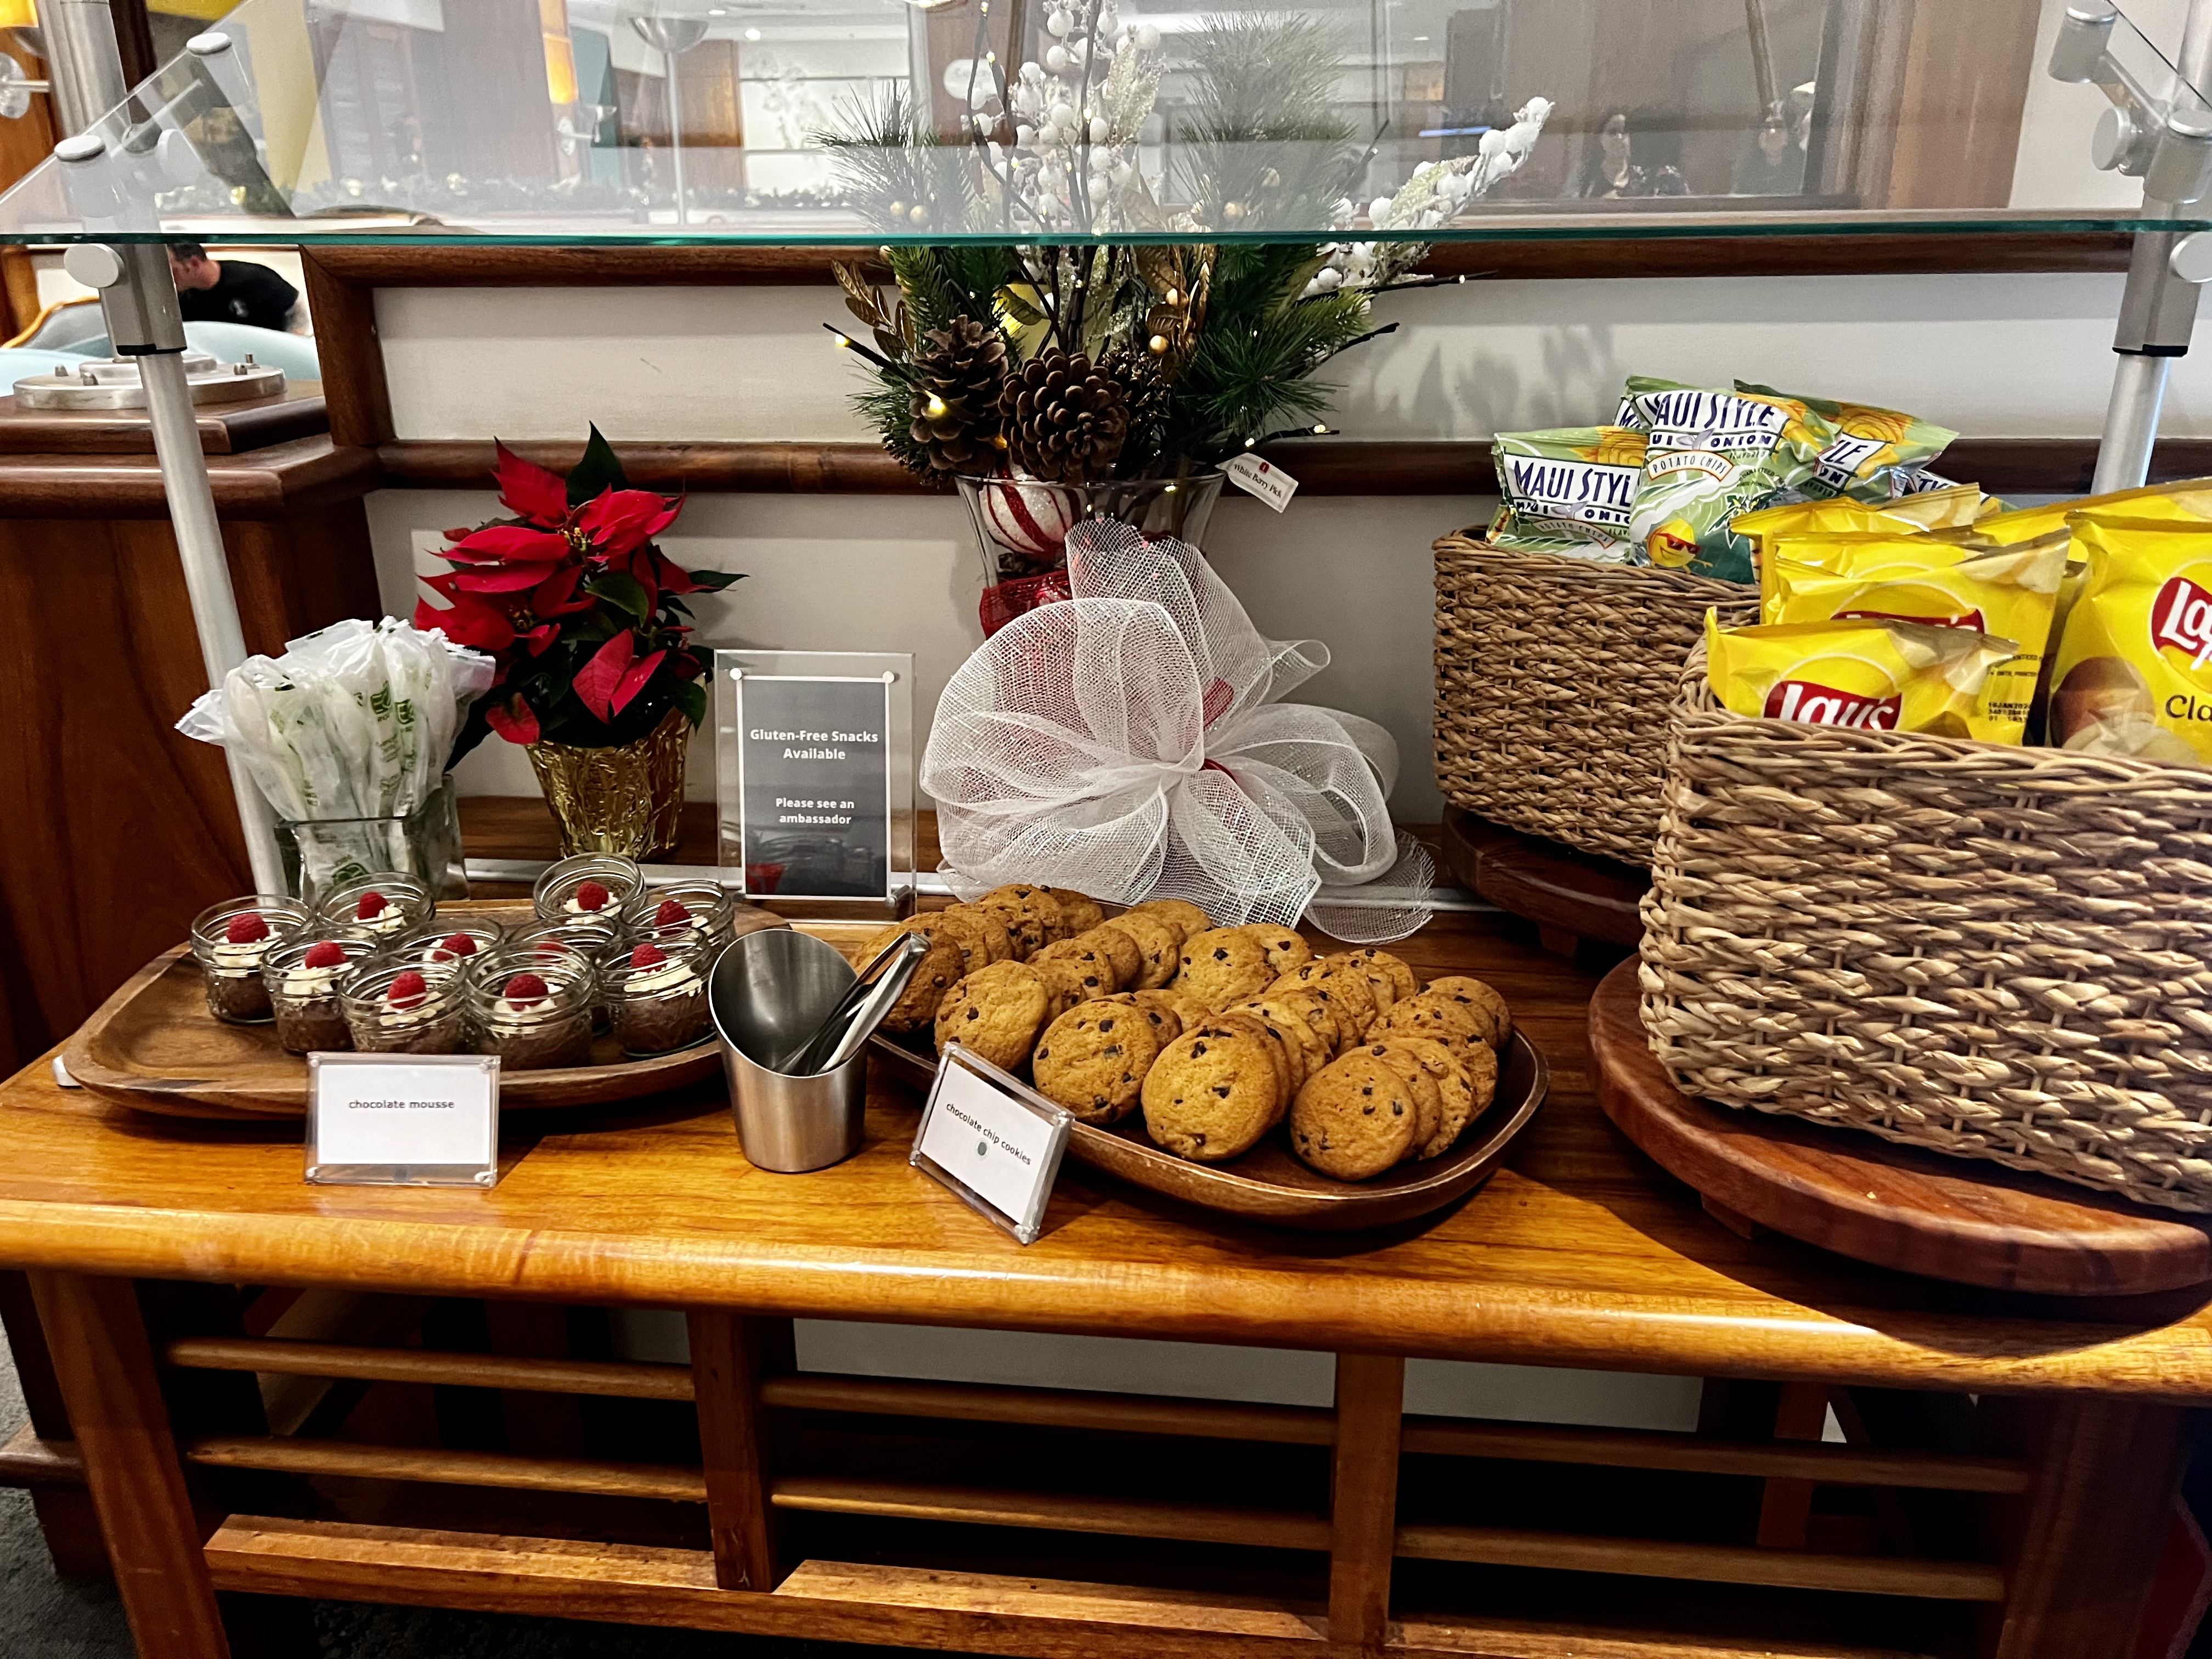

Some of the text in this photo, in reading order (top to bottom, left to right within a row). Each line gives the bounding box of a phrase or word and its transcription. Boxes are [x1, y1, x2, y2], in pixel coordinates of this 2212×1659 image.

[1703, 394, 1774, 430] STYLE
[1710, 434, 1772, 448] ONION
[1653, 455, 1727, 474] POTATO CHIPS
[1234, 464, 1282, 499] White Berry Pick
[1513, 460, 1632, 507] MAUI STYL
[1584, 509, 1630, 524] ONI
[750, 729, 879, 743] Gluten-Free Snacks
[783, 747, 846, 760] Available
[775, 797, 855, 809] Please see an
[779, 814, 852, 825] ambassador
[348, 1099, 455, 1109] chocolate mousse
[946, 1102, 1031, 1166] chocolate chip cookies
